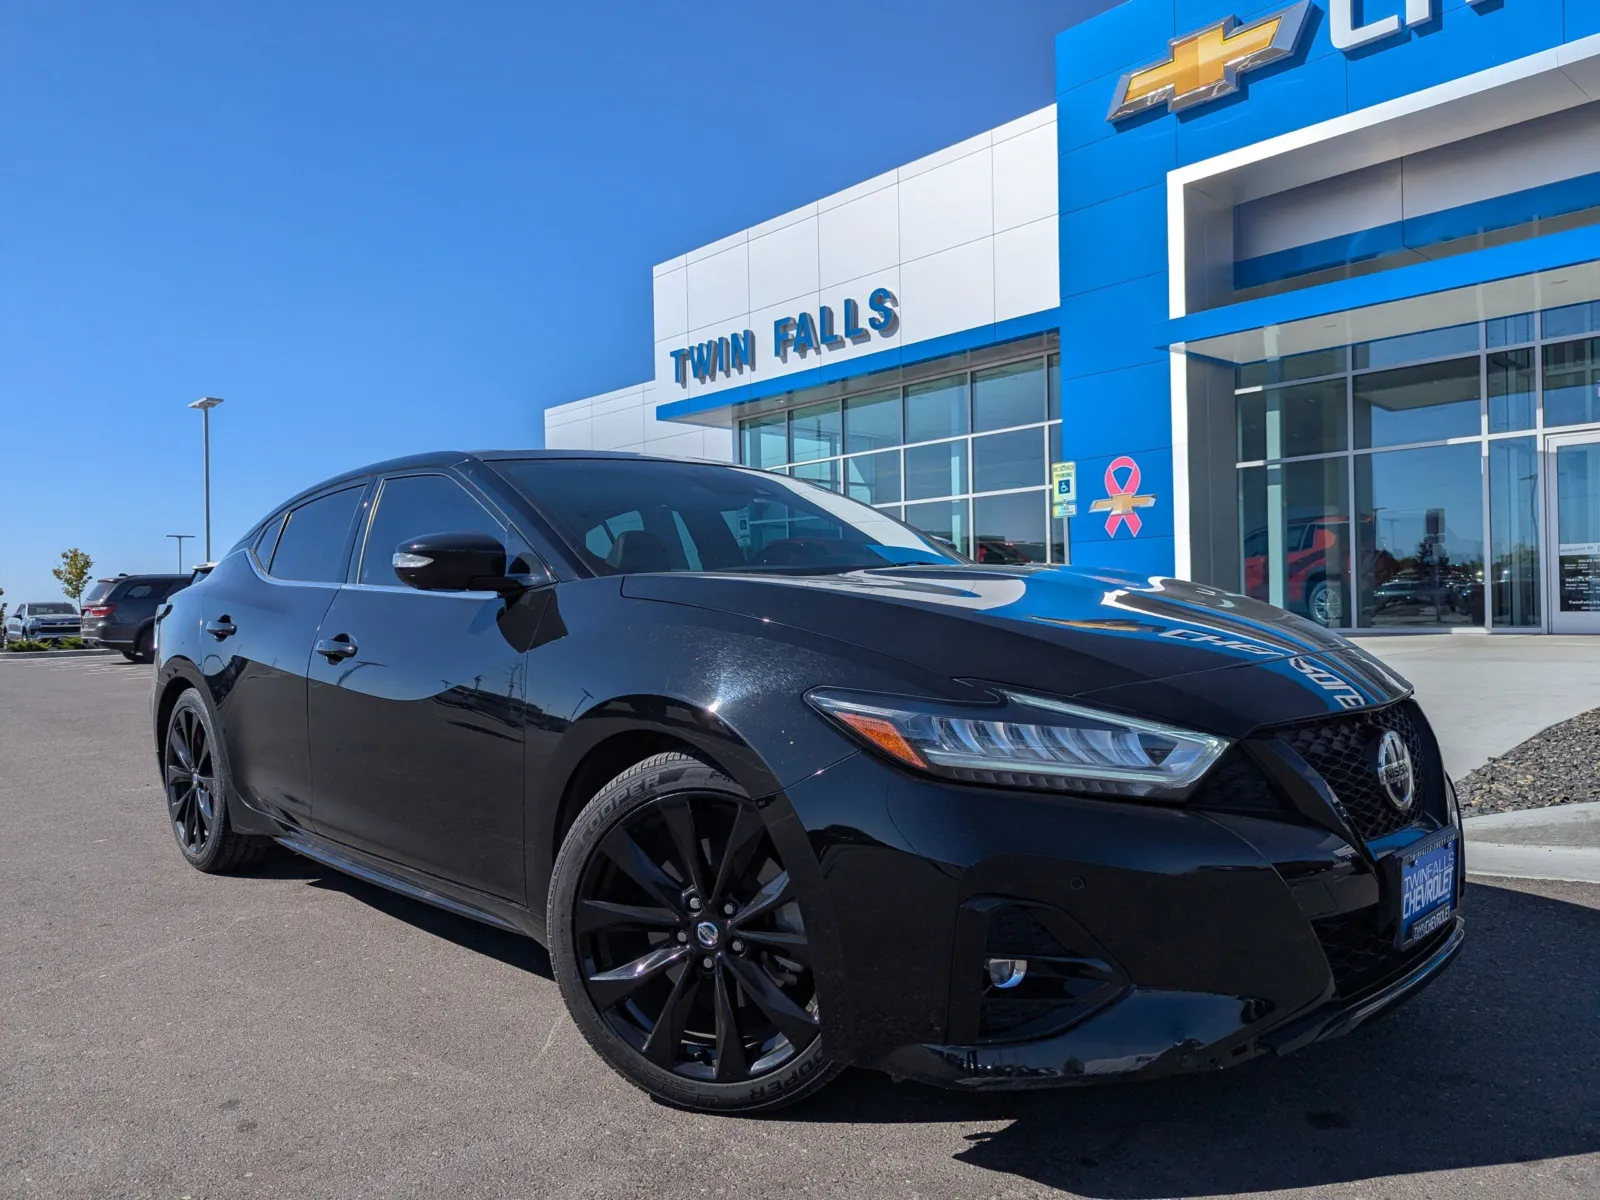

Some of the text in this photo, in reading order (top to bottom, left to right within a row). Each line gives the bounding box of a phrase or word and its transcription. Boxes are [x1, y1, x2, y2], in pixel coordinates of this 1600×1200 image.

[670, 287, 899, 386] TWIN FALLS
[578, 774, 660, 845] COOPER
[1402, 866, 1454, 920] CHEVROLET
[750, 1048, 824, 1100] OOPER
